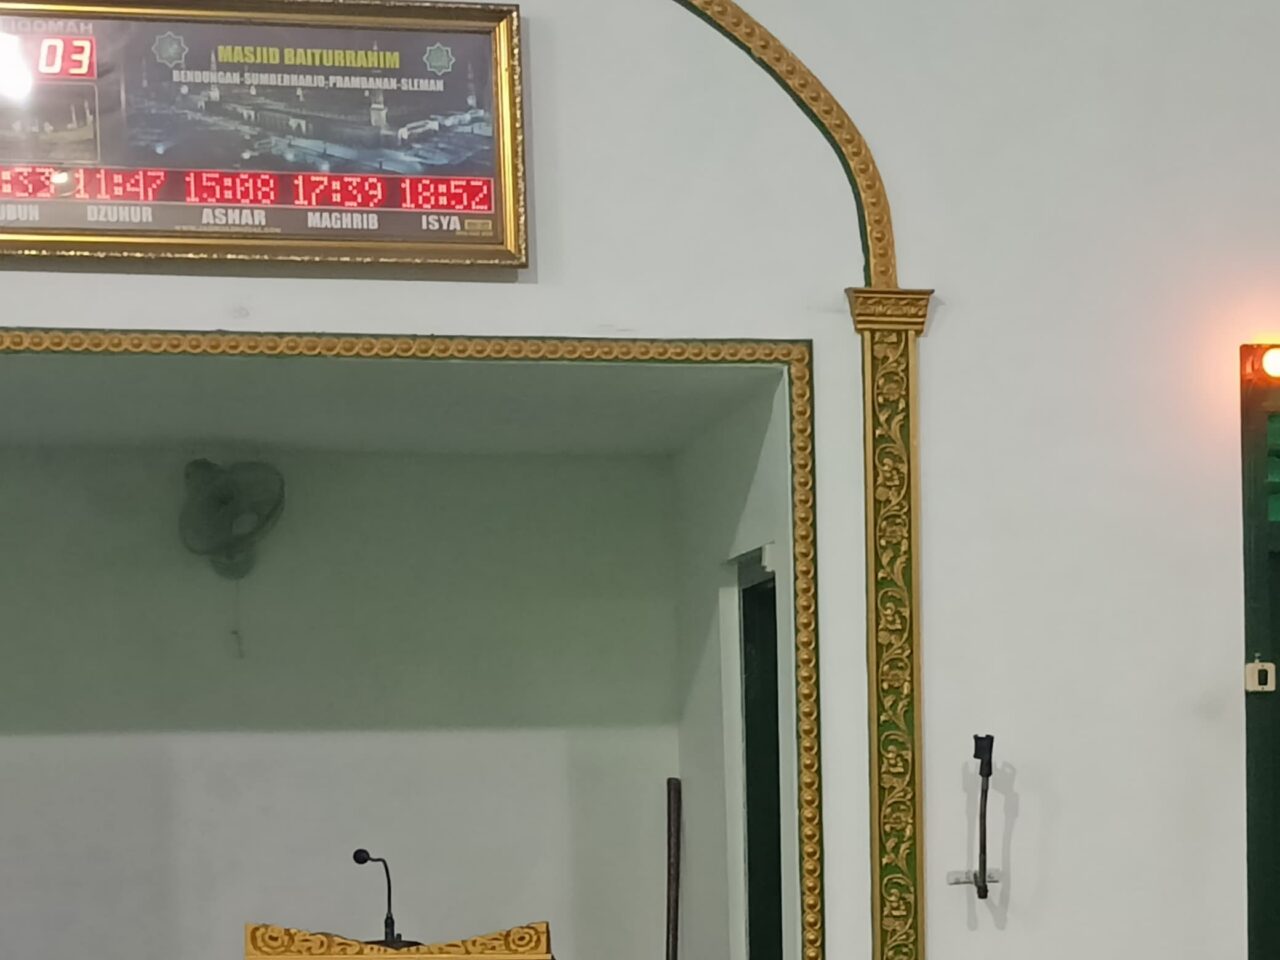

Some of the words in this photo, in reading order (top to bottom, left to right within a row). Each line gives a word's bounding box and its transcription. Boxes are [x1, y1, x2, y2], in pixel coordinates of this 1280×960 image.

[38, 38, 91, 75] 03
[217, 45, 281, 64] MASJID
[284, 48, 400, 69] BAITURRAHIM
[74, 168, 165, 200] 11:47
[185, 172, 275, 205] 15:08
[293, 175, 382, 208] 17:39
[400, 178, 488, 210] 18:52
[86, 205, 153, 223] DZUHUR
[202, 208, 267, 226] ASHAR
[307, 211, 379, 230] MAGHRIB
[421, 214, 461, 231] ISYA
